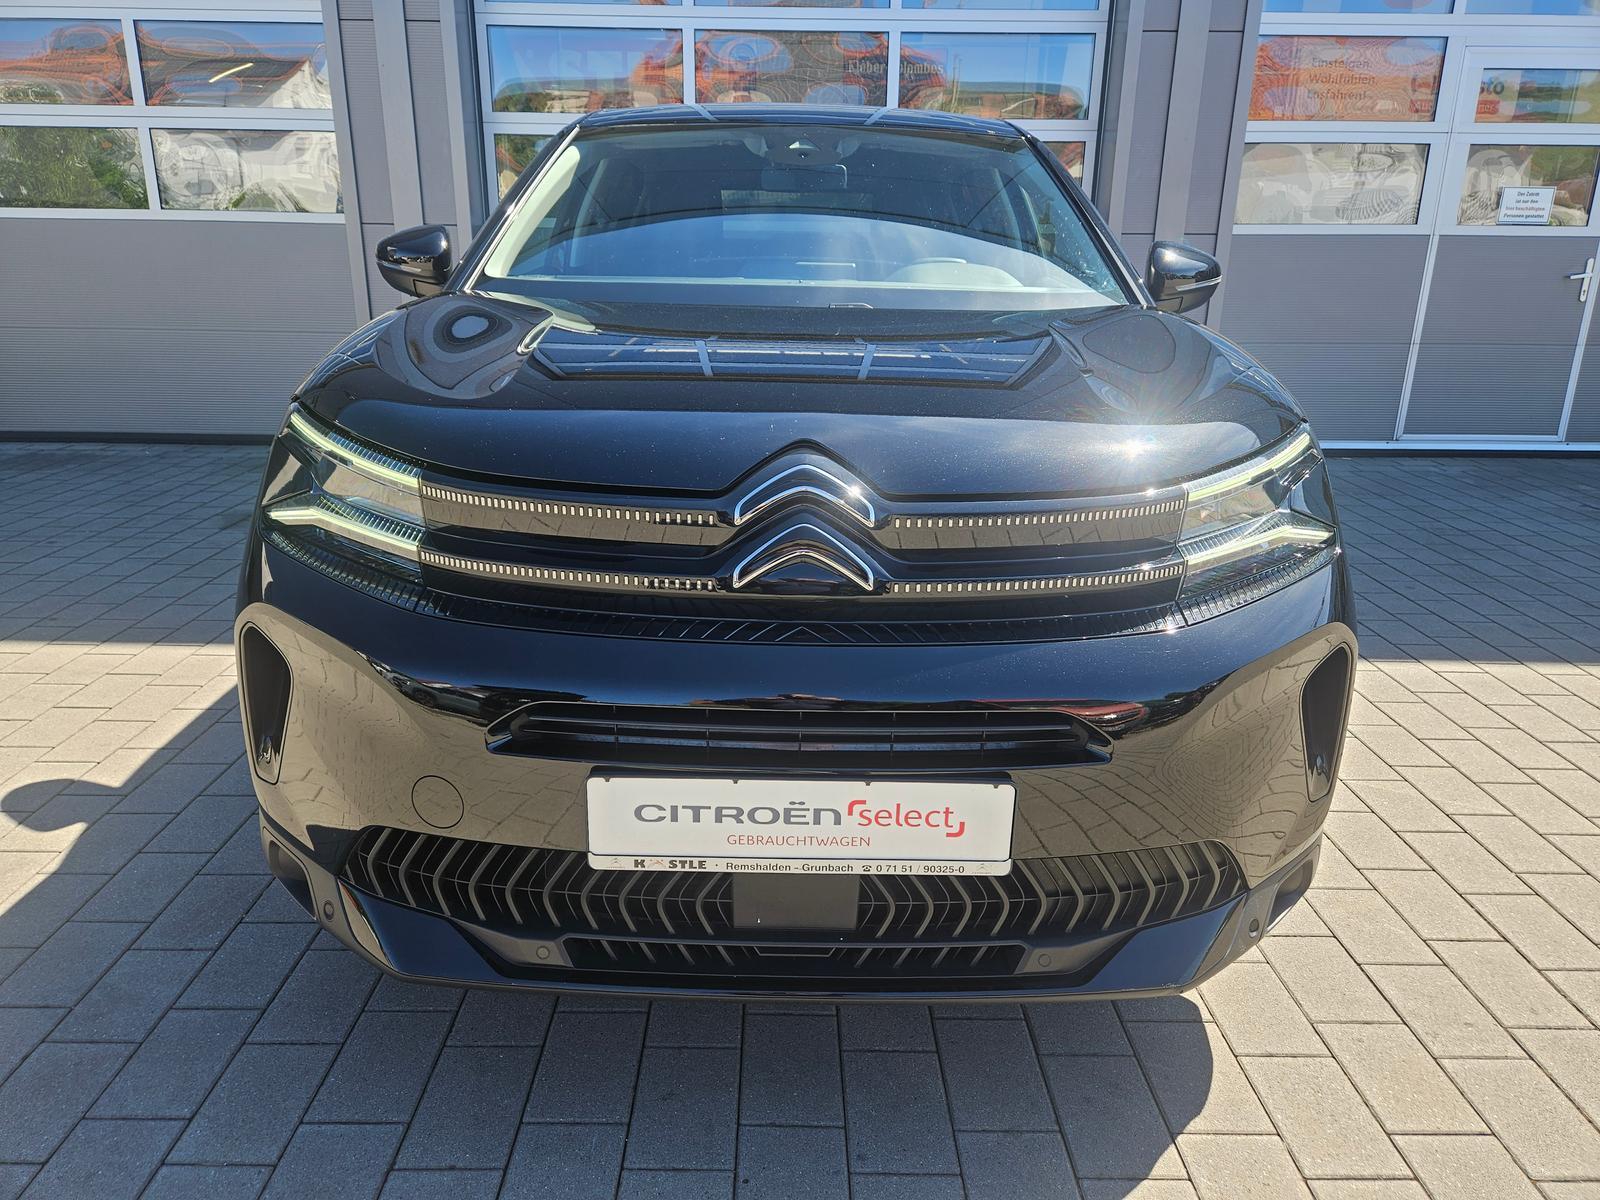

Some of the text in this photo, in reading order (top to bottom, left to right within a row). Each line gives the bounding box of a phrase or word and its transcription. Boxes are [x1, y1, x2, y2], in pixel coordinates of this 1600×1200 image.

[857, 802, 955, 829] select
[727, 833, 871, 848] GEBRAUCHTWAGEN
[725, 861, 791, 872] Remshalden
[801, 863, 854, 873] Grunbach
[923, 865, 965, 875] 90325-0
